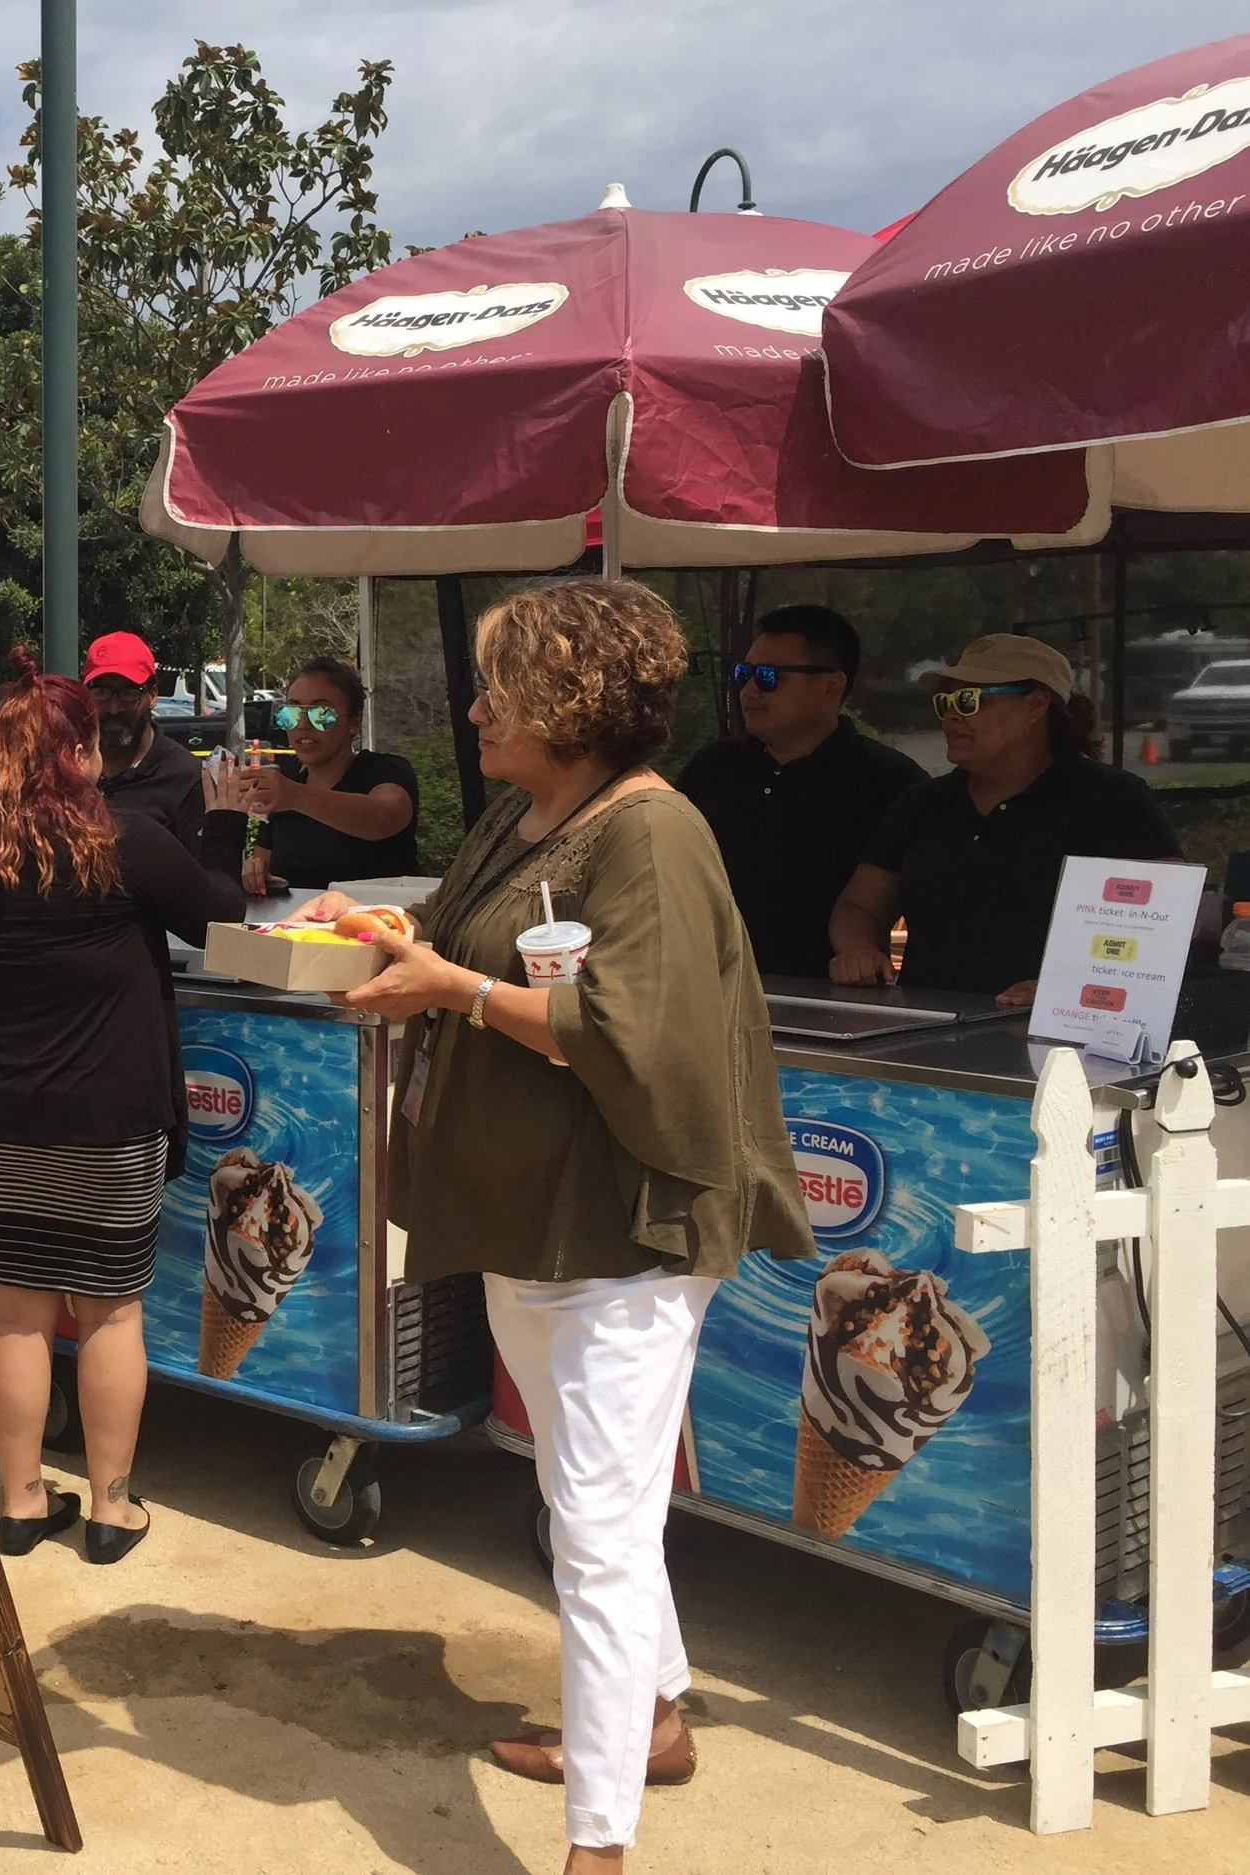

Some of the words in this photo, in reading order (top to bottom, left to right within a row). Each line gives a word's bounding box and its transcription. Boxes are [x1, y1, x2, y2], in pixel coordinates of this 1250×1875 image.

[924, 246, 1012, 281] made
[1019, 230, 1078, 260] like
[1085, 220, 1131, 245] no
[1140, 193, 1246, 232] other
[349, 298, 555, 331] Häagen-Dazs
[714, 345, 800, 360] made
[262, 370, 335, 389] made
[343, 367, 390, 380] like
[1076, 904, 1096, 914] PINK
[1129, 910, 1169, 922] In-N-Out
[1103, 939, 1126, 948] ADMIT
[1121, 969, 1135, 978] ice
[1136, 972, 1166, 982] cream
[1052, 1007, 1089, 1021] ORANGE
[185, 1084, 242, 1115] estlé
[801, 1132, 854, 1157] CREAM
[797, 1170, 863, 1209] estlé
